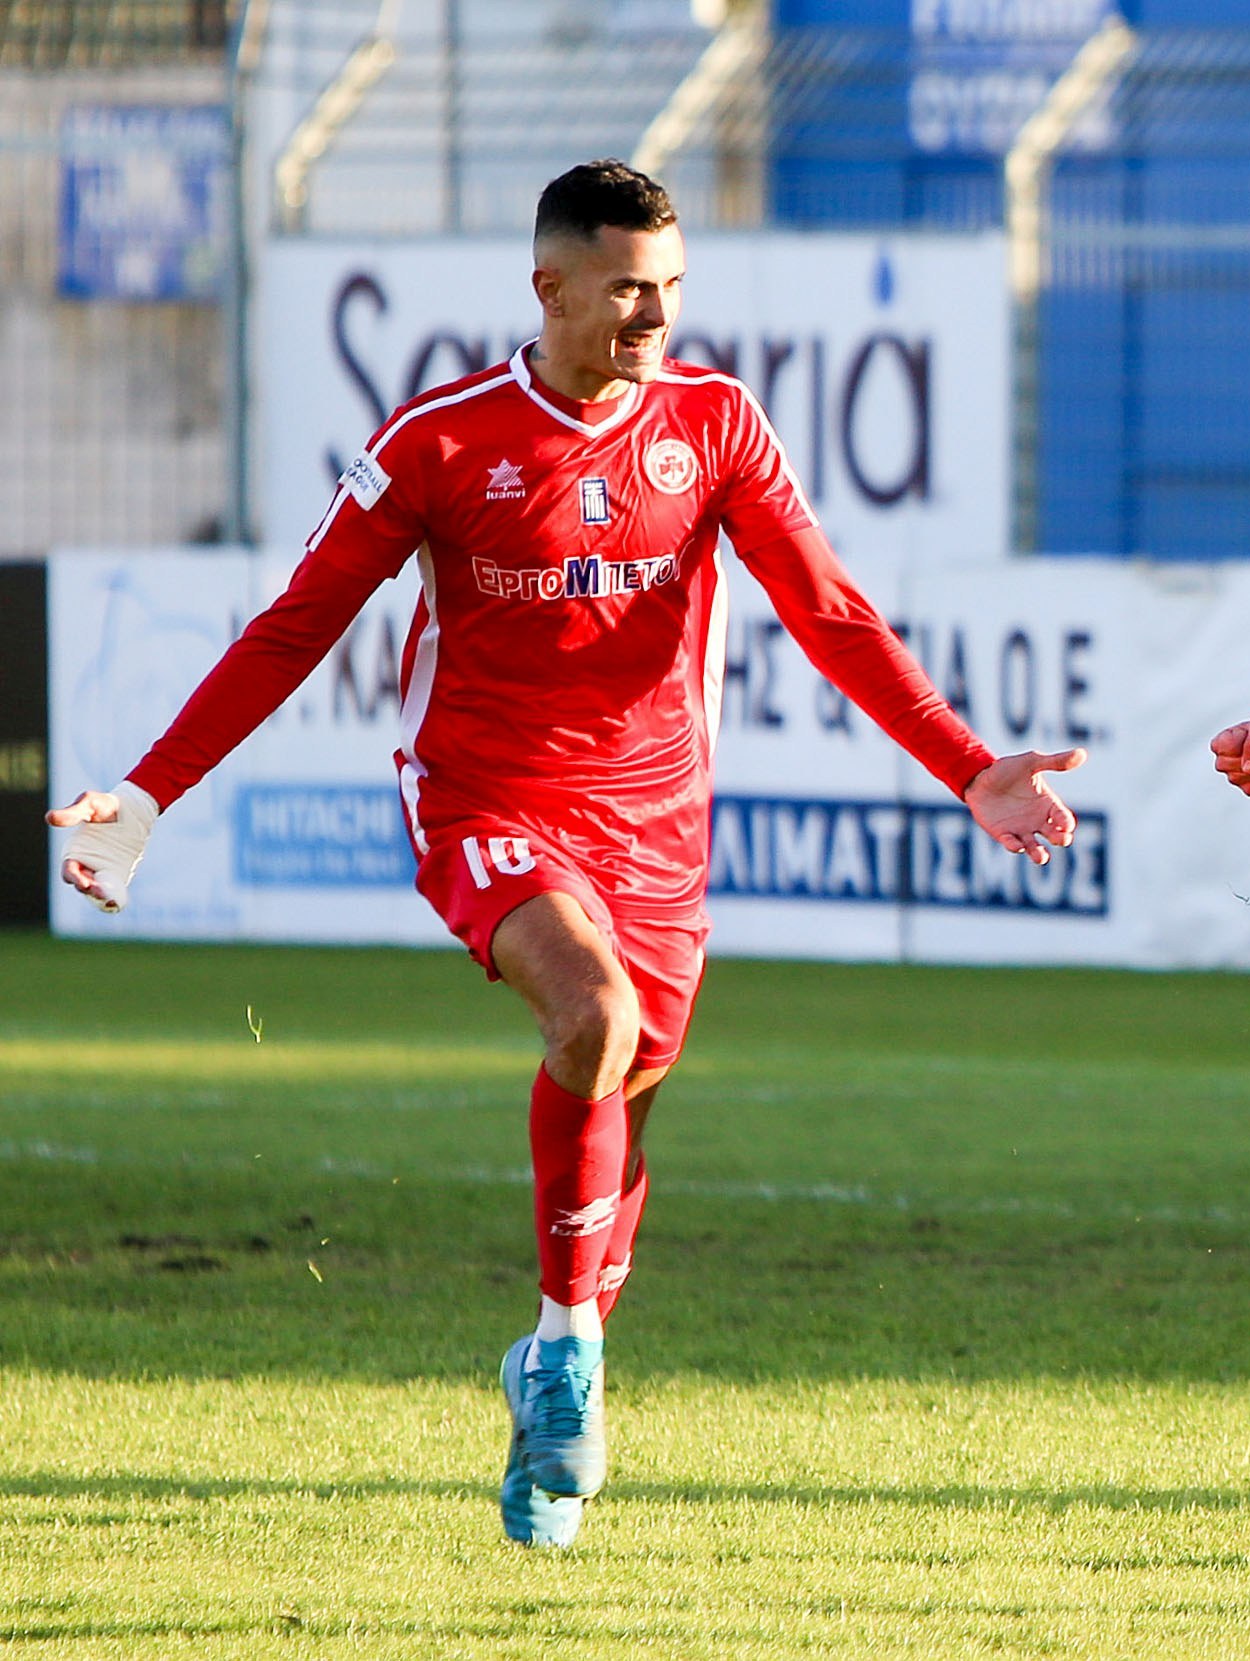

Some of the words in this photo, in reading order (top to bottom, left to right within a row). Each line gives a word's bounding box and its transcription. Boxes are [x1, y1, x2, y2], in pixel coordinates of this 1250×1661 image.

[486, 487, 526, 500] luanvi
[461, 836, 537, 890] 10
[706, 803, 1104, 908] ΛΙΜΑΤΙΣΜΟΣ
